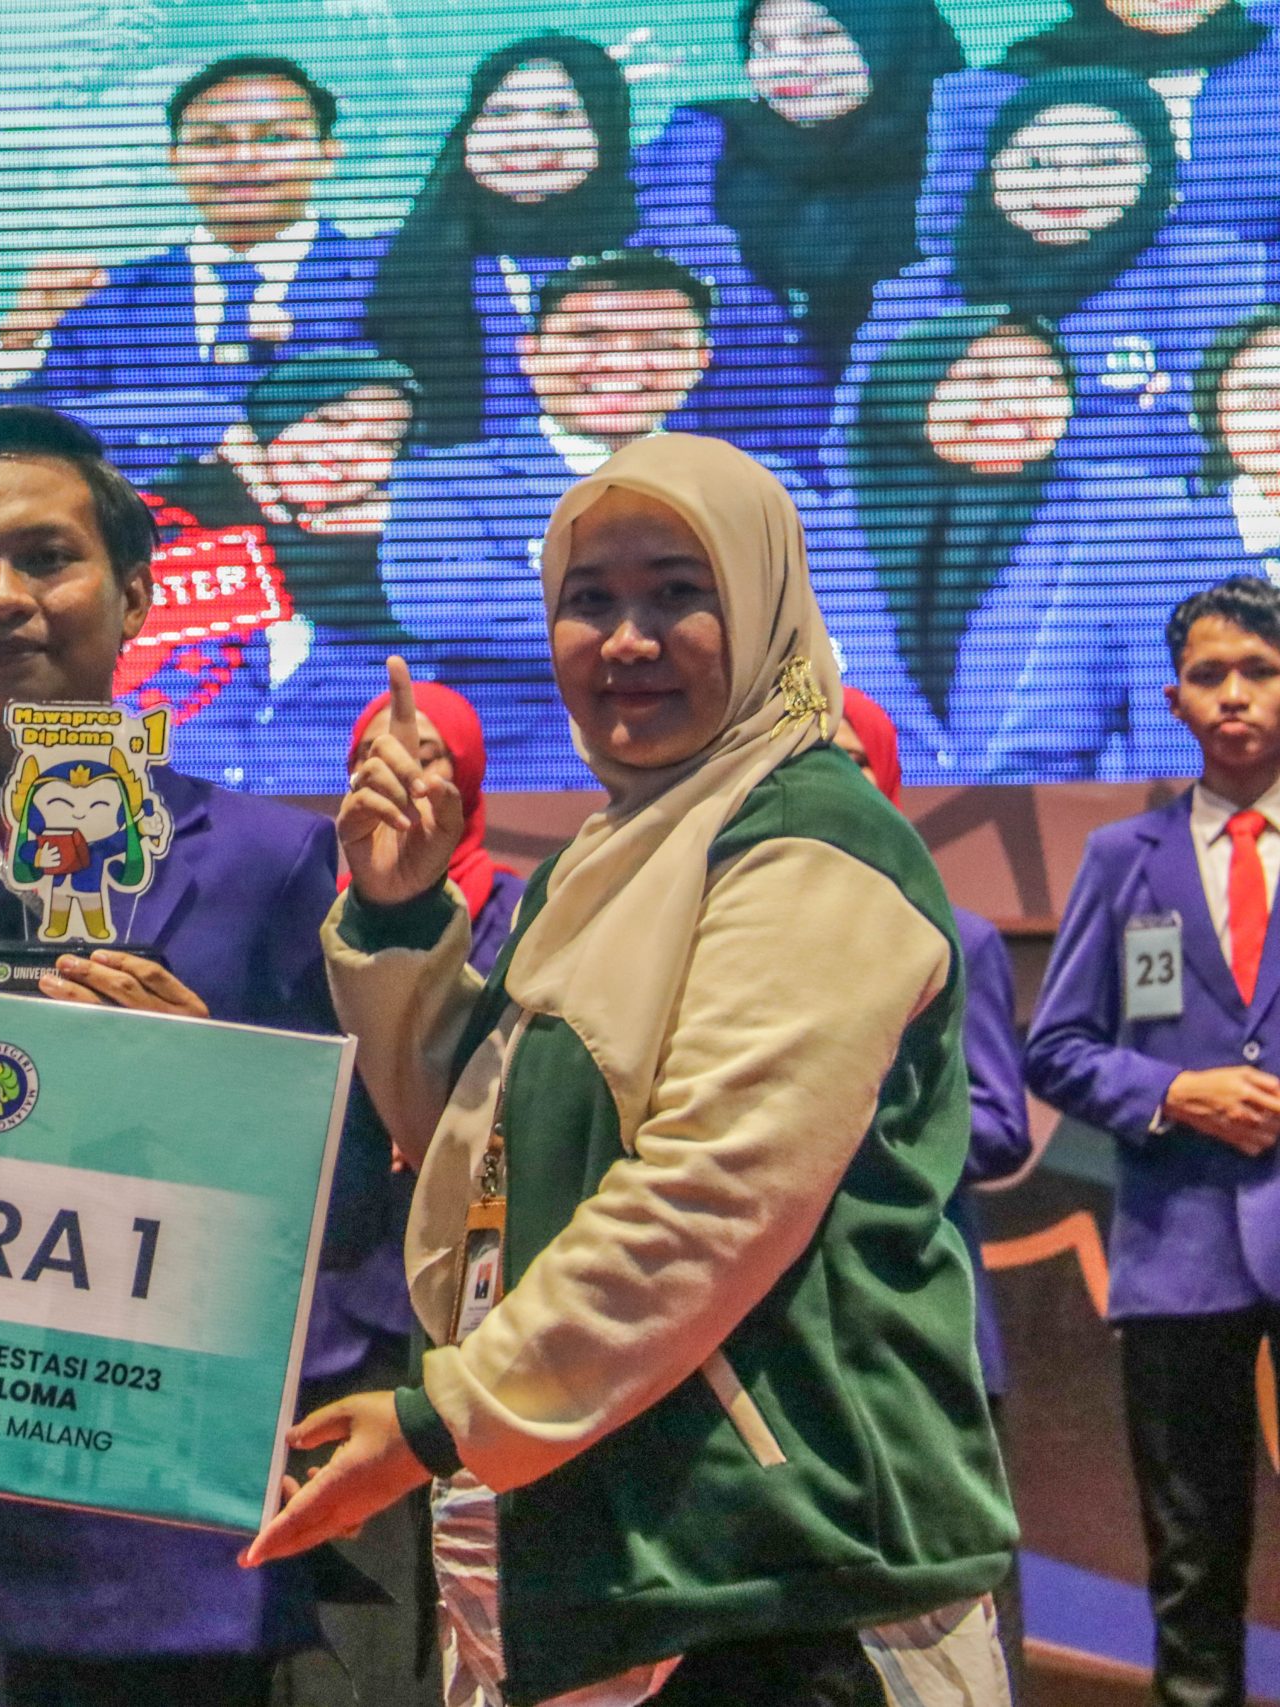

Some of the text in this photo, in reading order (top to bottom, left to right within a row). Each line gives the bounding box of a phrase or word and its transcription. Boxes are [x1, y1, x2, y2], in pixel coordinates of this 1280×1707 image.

[14, 707, 122, 728] Mawapres
[22, 727, 114, 748] Diploma
[13, 966, 62, 980] UNIVERSIT
[1136, 951, 1175, 987] 23
[130, 1216, 161, 1300] 1
[94, 1359, 162, 1393] 2023
[6, 1416, 113, 1452] MALANG
